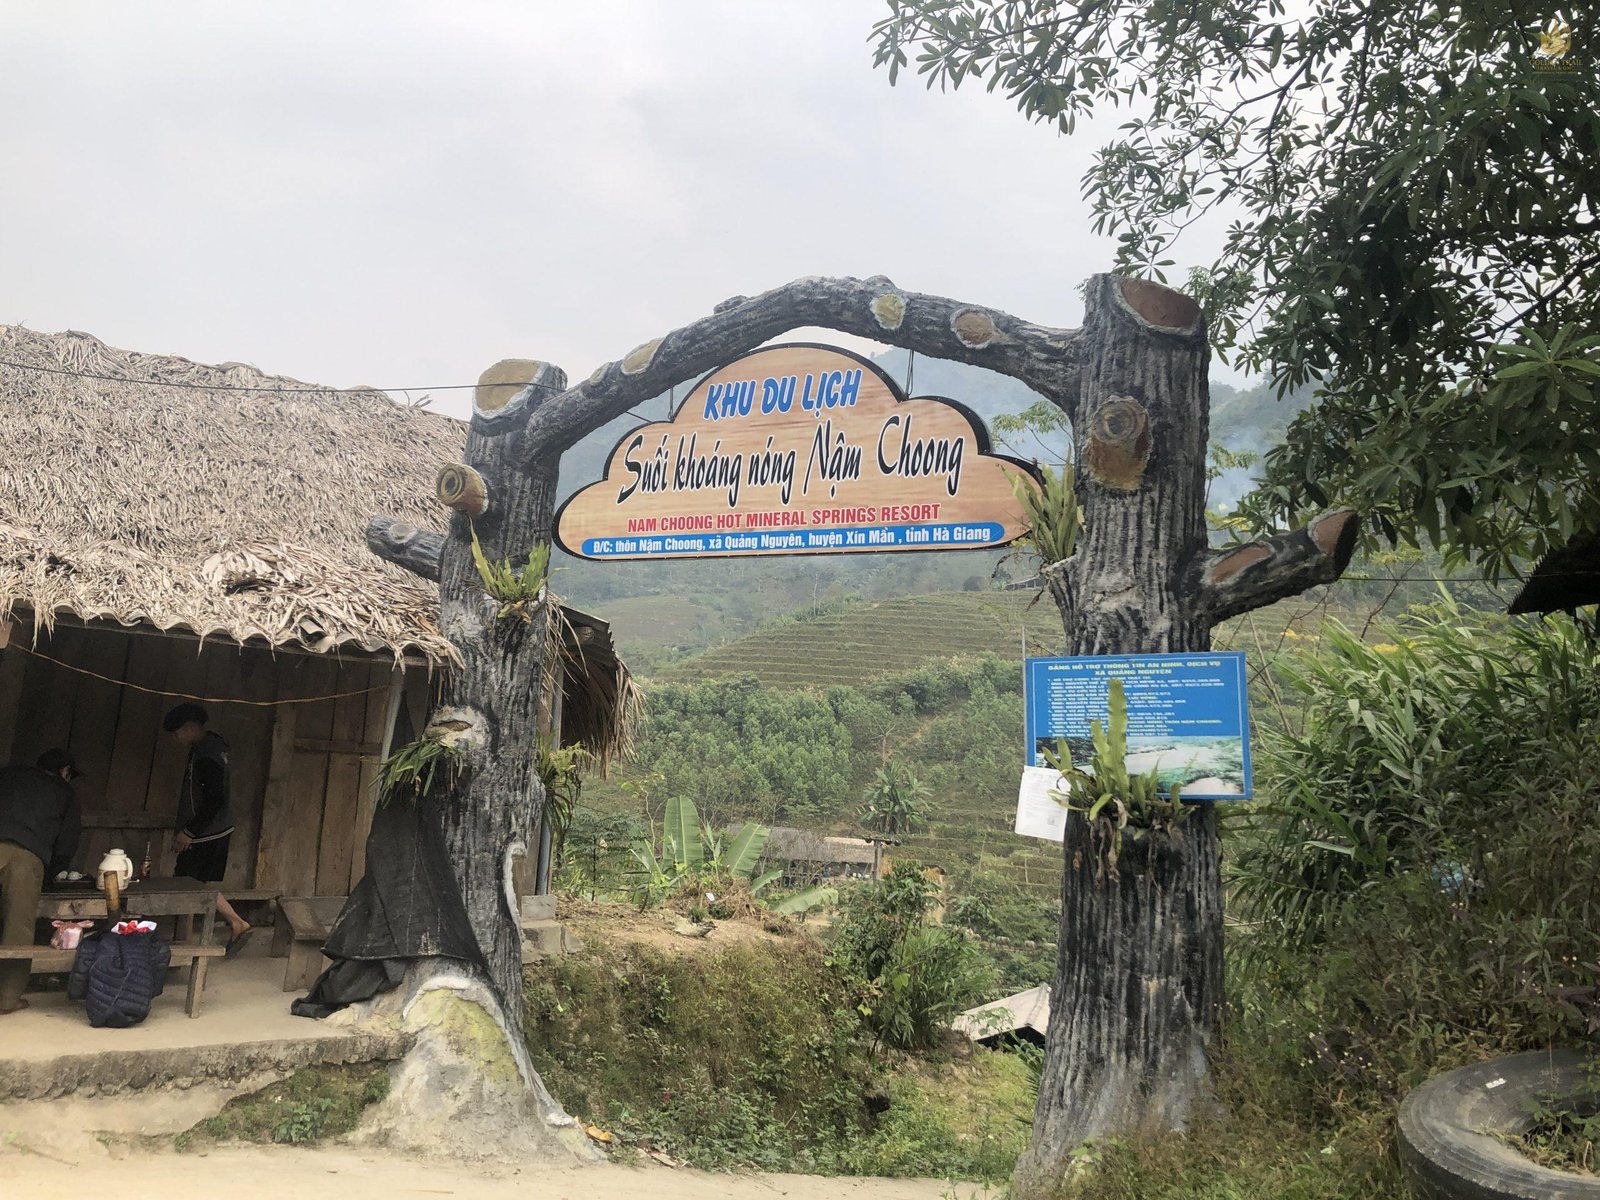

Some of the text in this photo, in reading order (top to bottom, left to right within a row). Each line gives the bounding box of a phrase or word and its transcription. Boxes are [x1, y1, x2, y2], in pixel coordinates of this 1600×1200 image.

[703, 369, 862, 421] KHU DU LỊCH
[617, 414, 964, 507] Suối khoáng nóng Nậm Choong
[627, 503, 941, 533] NAM CHOONG HOT MINERAL SPRINGS RESORT
[639, 538, 662, 554] Nậm
[665, 537, 706, 552] Choong,
[709, 535, 722, 549] xã
[725, 533, 757, 549] Quảng
[761, 533, 805, 550] Nguyên,
[808, 531, 842, 548] huyện
[846, 530, 865, 545] Xín
[868, 527, 895, 543] Mần
[905, 527, 929, 542] tỉnh
[933, 527, 949, 542] Hà
[953, 527, 991, 542] Giang
